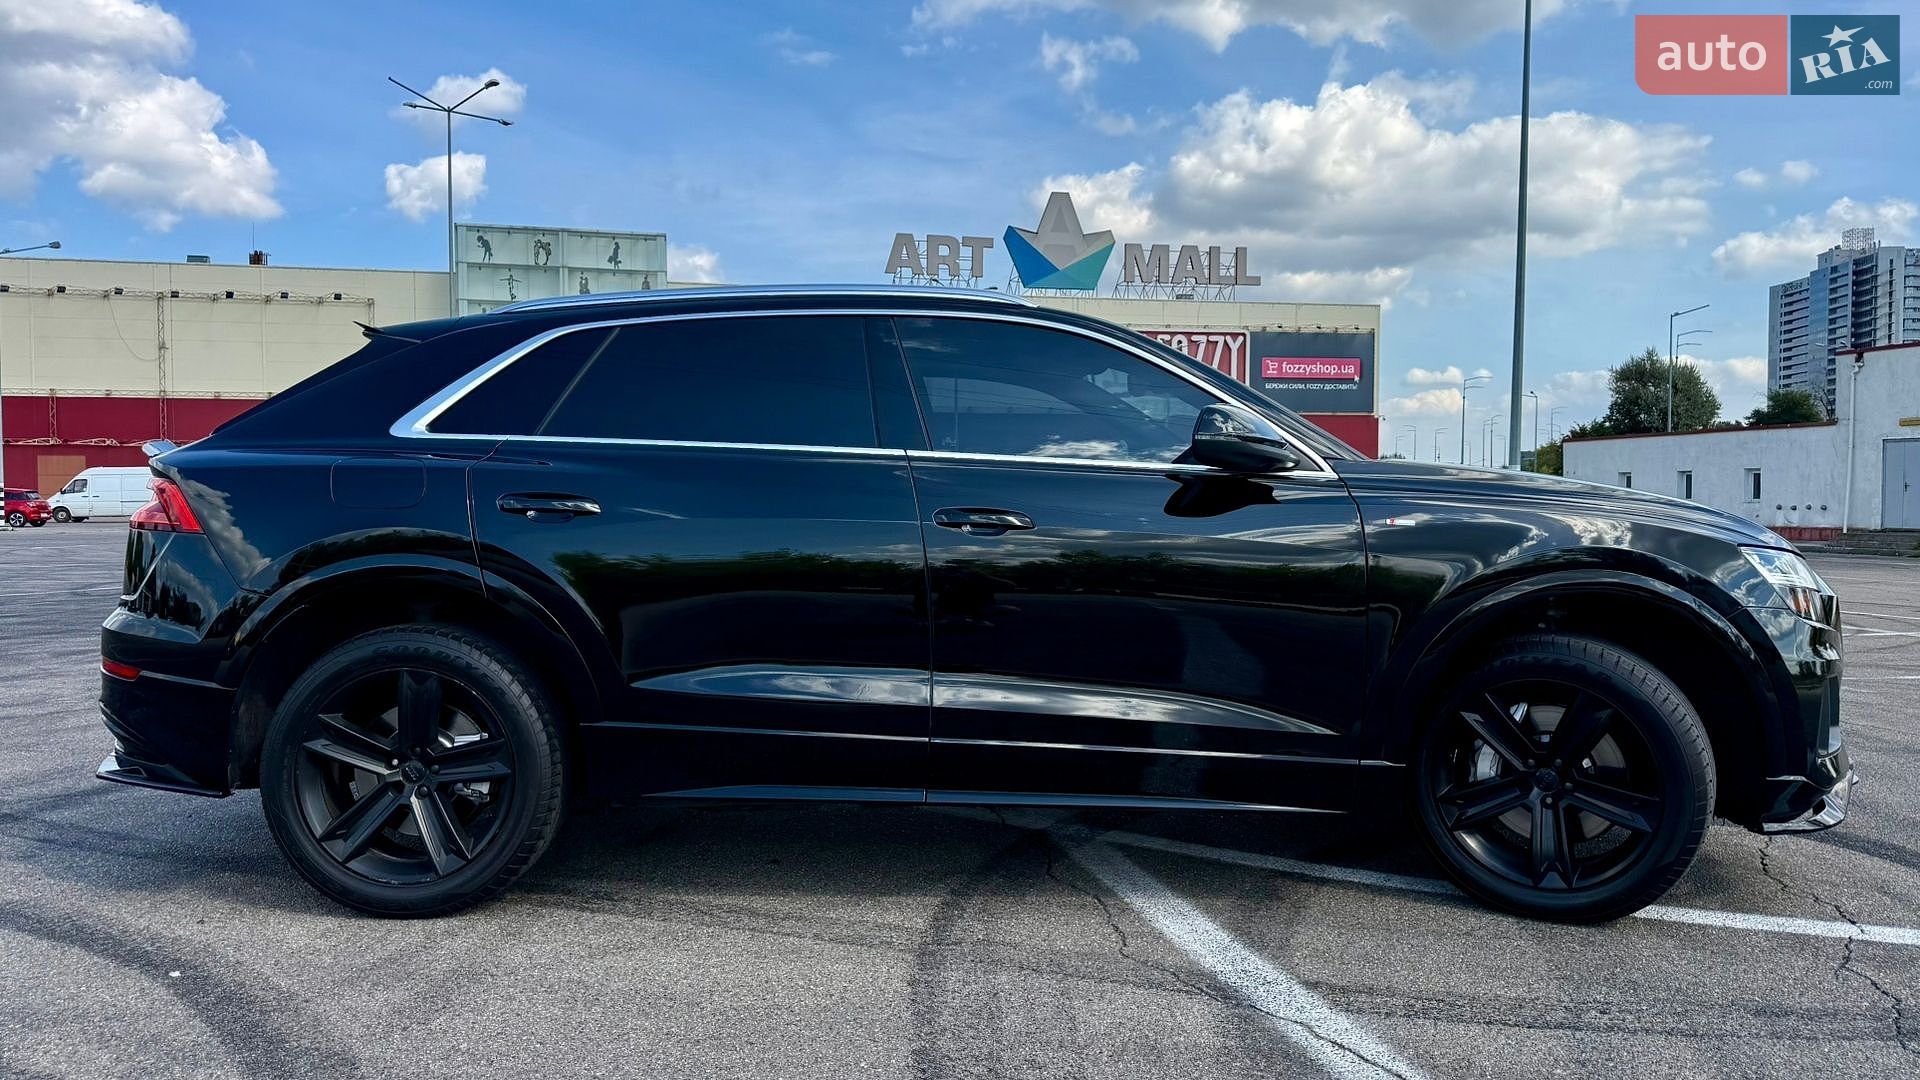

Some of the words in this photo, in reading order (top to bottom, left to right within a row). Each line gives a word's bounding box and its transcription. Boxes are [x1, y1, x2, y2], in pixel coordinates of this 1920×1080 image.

[885, 232, 994, 278] ART
[1124, 243, 1261, 286] MALL
[1156, 333, 1244, 380] ZZY
[1282, 360, 1355, 375] fozzyshop.ua
